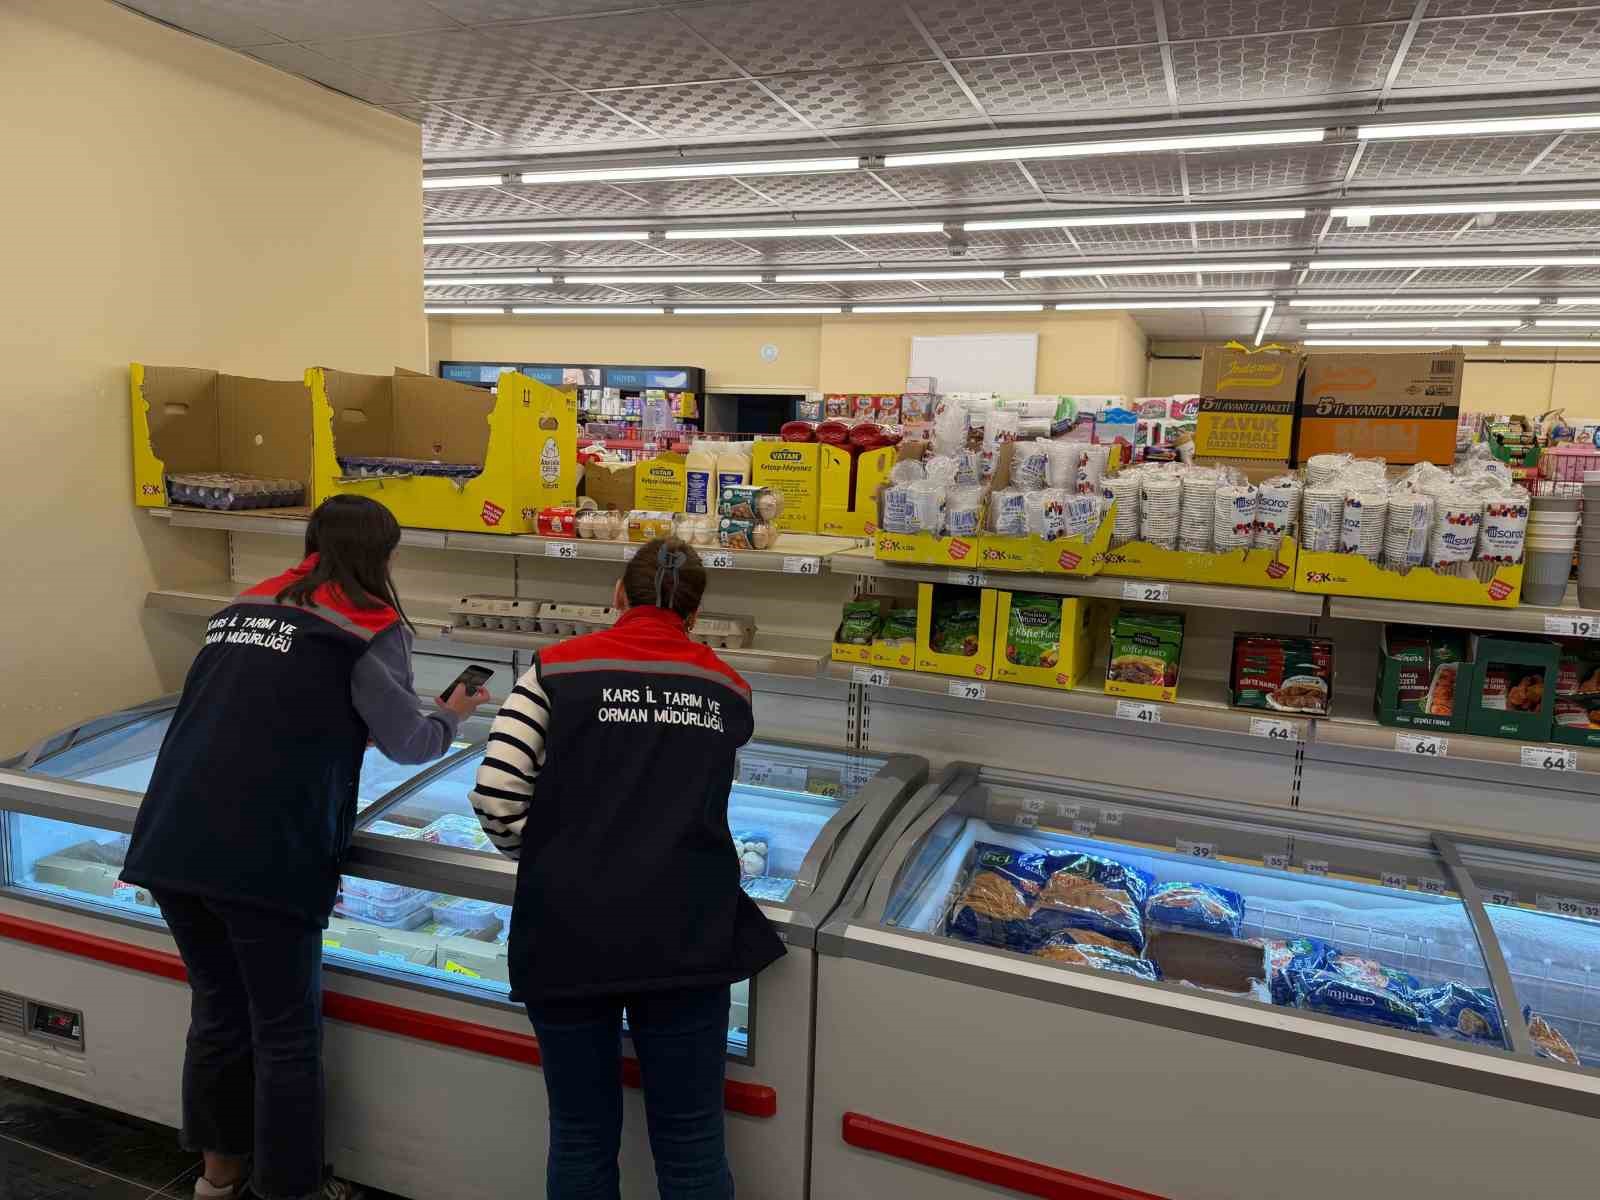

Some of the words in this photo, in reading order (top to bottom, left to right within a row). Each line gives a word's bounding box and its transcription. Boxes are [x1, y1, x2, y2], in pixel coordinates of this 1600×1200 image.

[1347, 405, 1398, 418] AVANTAJ
[1399, 402, 1443, 418] PAKETİ
[1209, 416, 1280, 432] TAVUK
[560, 546, 571, 557] 95
[713, 557, 726, 567] 65
[800, 563, 812, 573] 61
[967, 574, 980, 587] 31
[1143, 588, 1161, 601] 22
[241, 617, 277, 631] TARIM
[278, 621, 297, 635] VE
[1571, 622, 1590, 635] 19
[225, 629, 293, 653] MÜDÜRLÜĞÜ
[869, 673, 882, 685] 41
[965, 687, 979, 698] 79
[602, 688, 640, 704] KARS
[645, 685, 657, 704] İL
[663, 691, 703, 708] TARIM
[707, 698, 721, 715] VE
[598, 707, 648, 723] ORMAN
[653, 706, 725, 733] MÜDÜRLÜĞÜ
[1137, 710, 1152, 721] 41
[1269, 727, 1289, 739] 64
[1415, 742, 1437, 755] 64
[1542, 757, 1566, 770] 64
[1192, 846, 1209, 857] 39
[1557, 902, 1577, 913] 139
